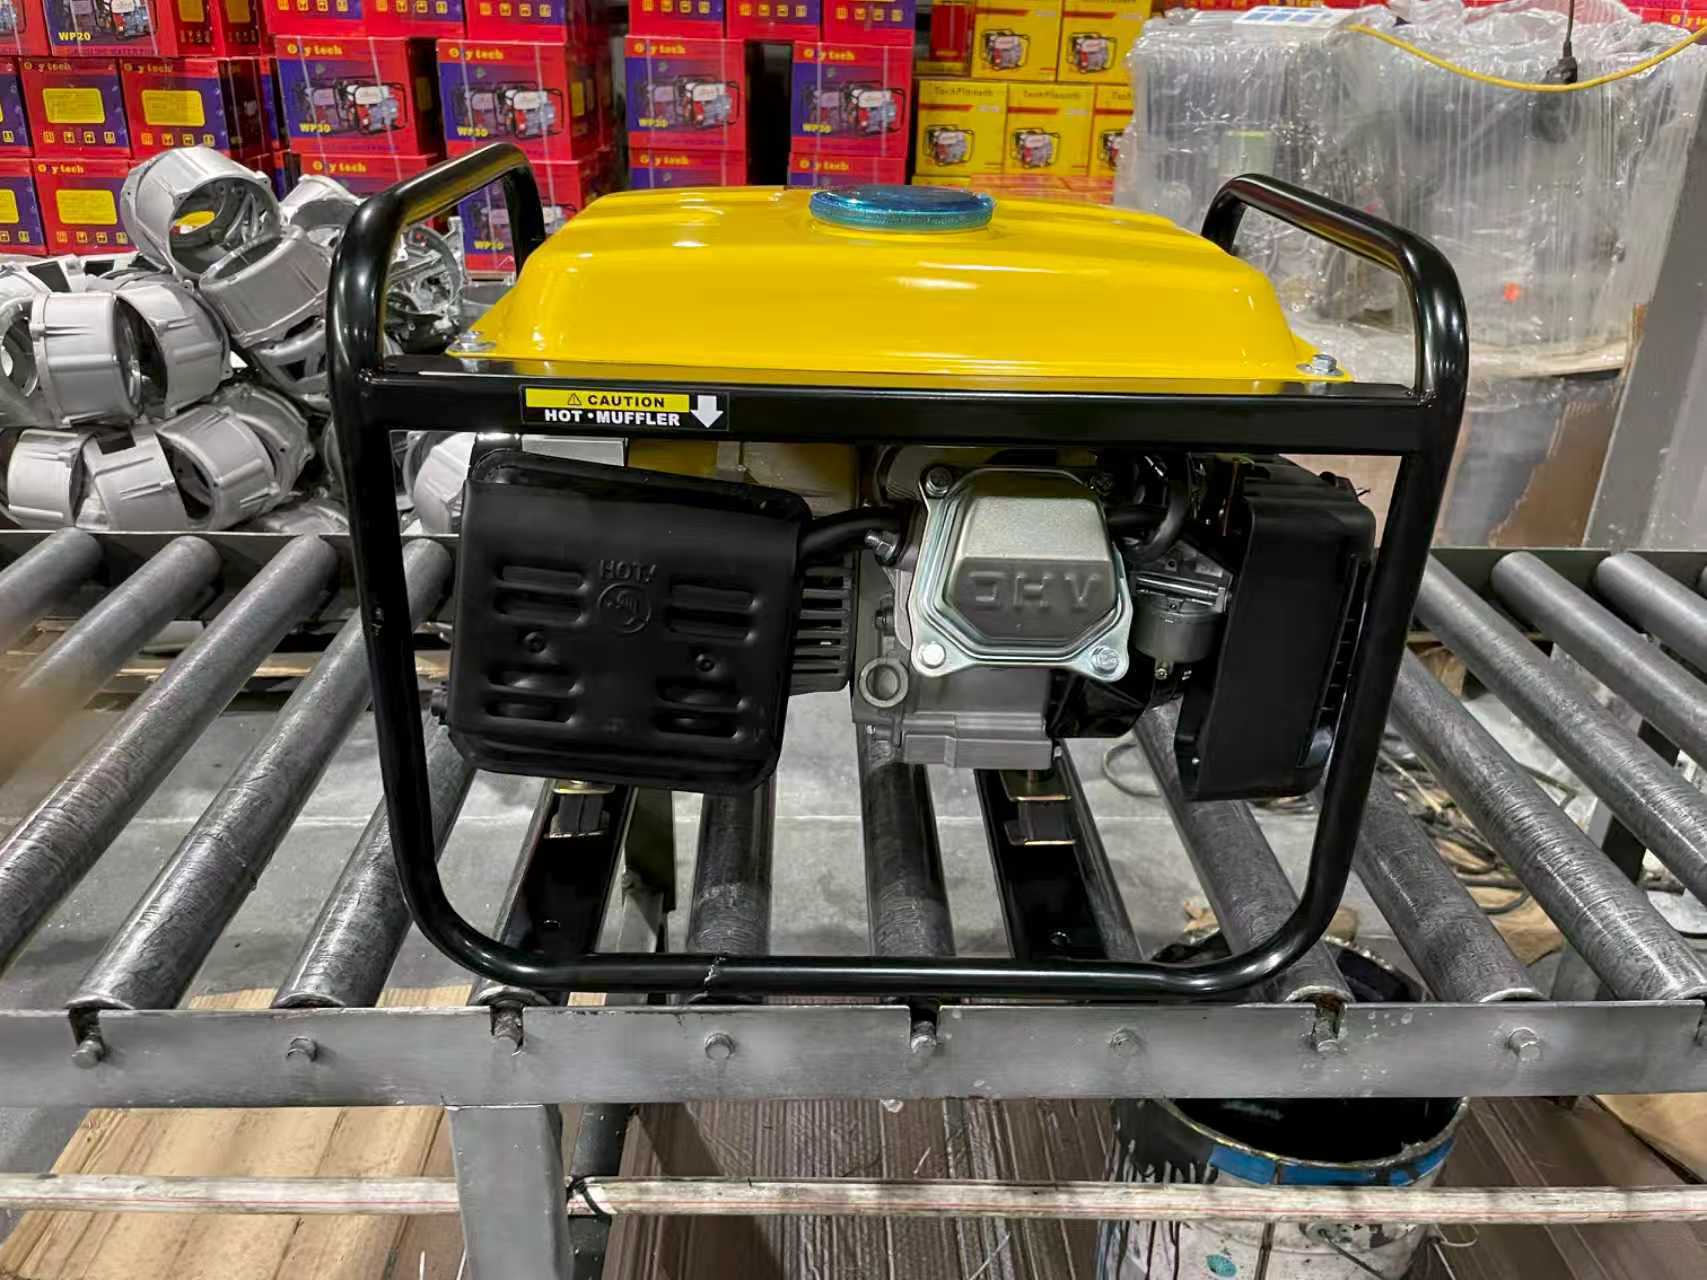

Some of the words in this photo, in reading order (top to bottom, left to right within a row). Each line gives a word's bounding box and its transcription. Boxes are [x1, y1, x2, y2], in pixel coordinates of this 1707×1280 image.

[58, 32, 91, 41] WP20
[587, 394, 665, 408] CAUTION
[544, 408, 583, 422] HOT
[596, 411, 681, 426] MUFFLER
